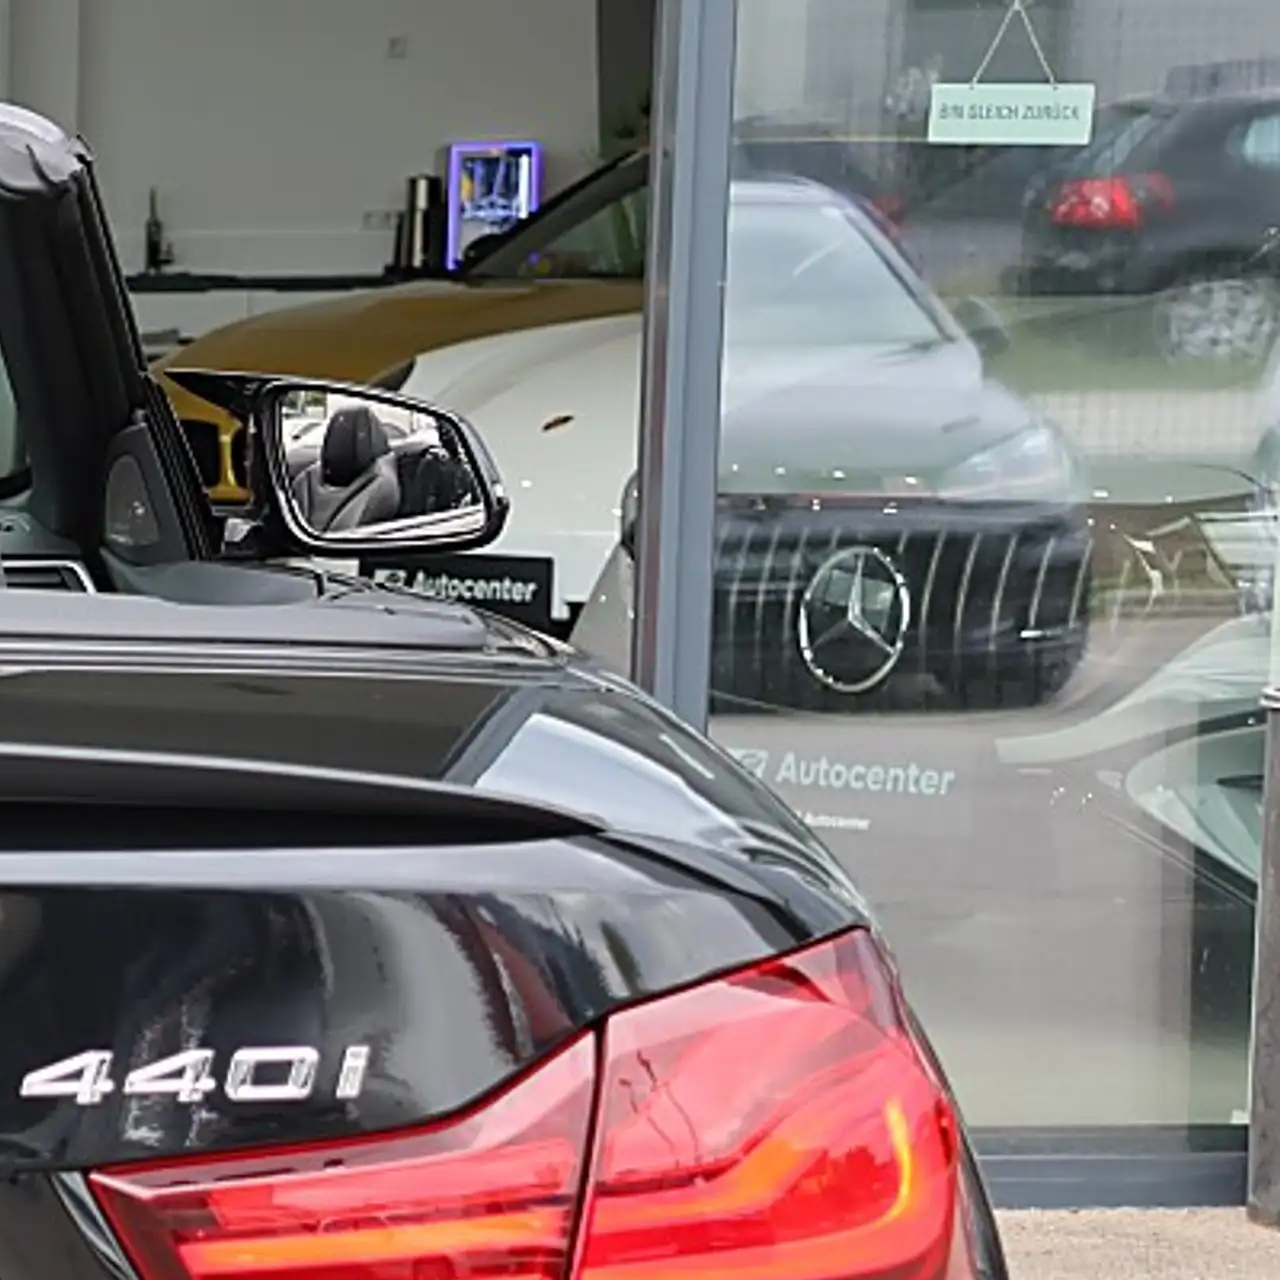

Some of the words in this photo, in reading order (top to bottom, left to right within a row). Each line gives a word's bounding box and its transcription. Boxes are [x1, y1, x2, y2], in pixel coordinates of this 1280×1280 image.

[411, 570, 538, 602] Autocenter
[775, 752, 956, 796] Autocenter
[19, 1046, 371, 1105] 440i
